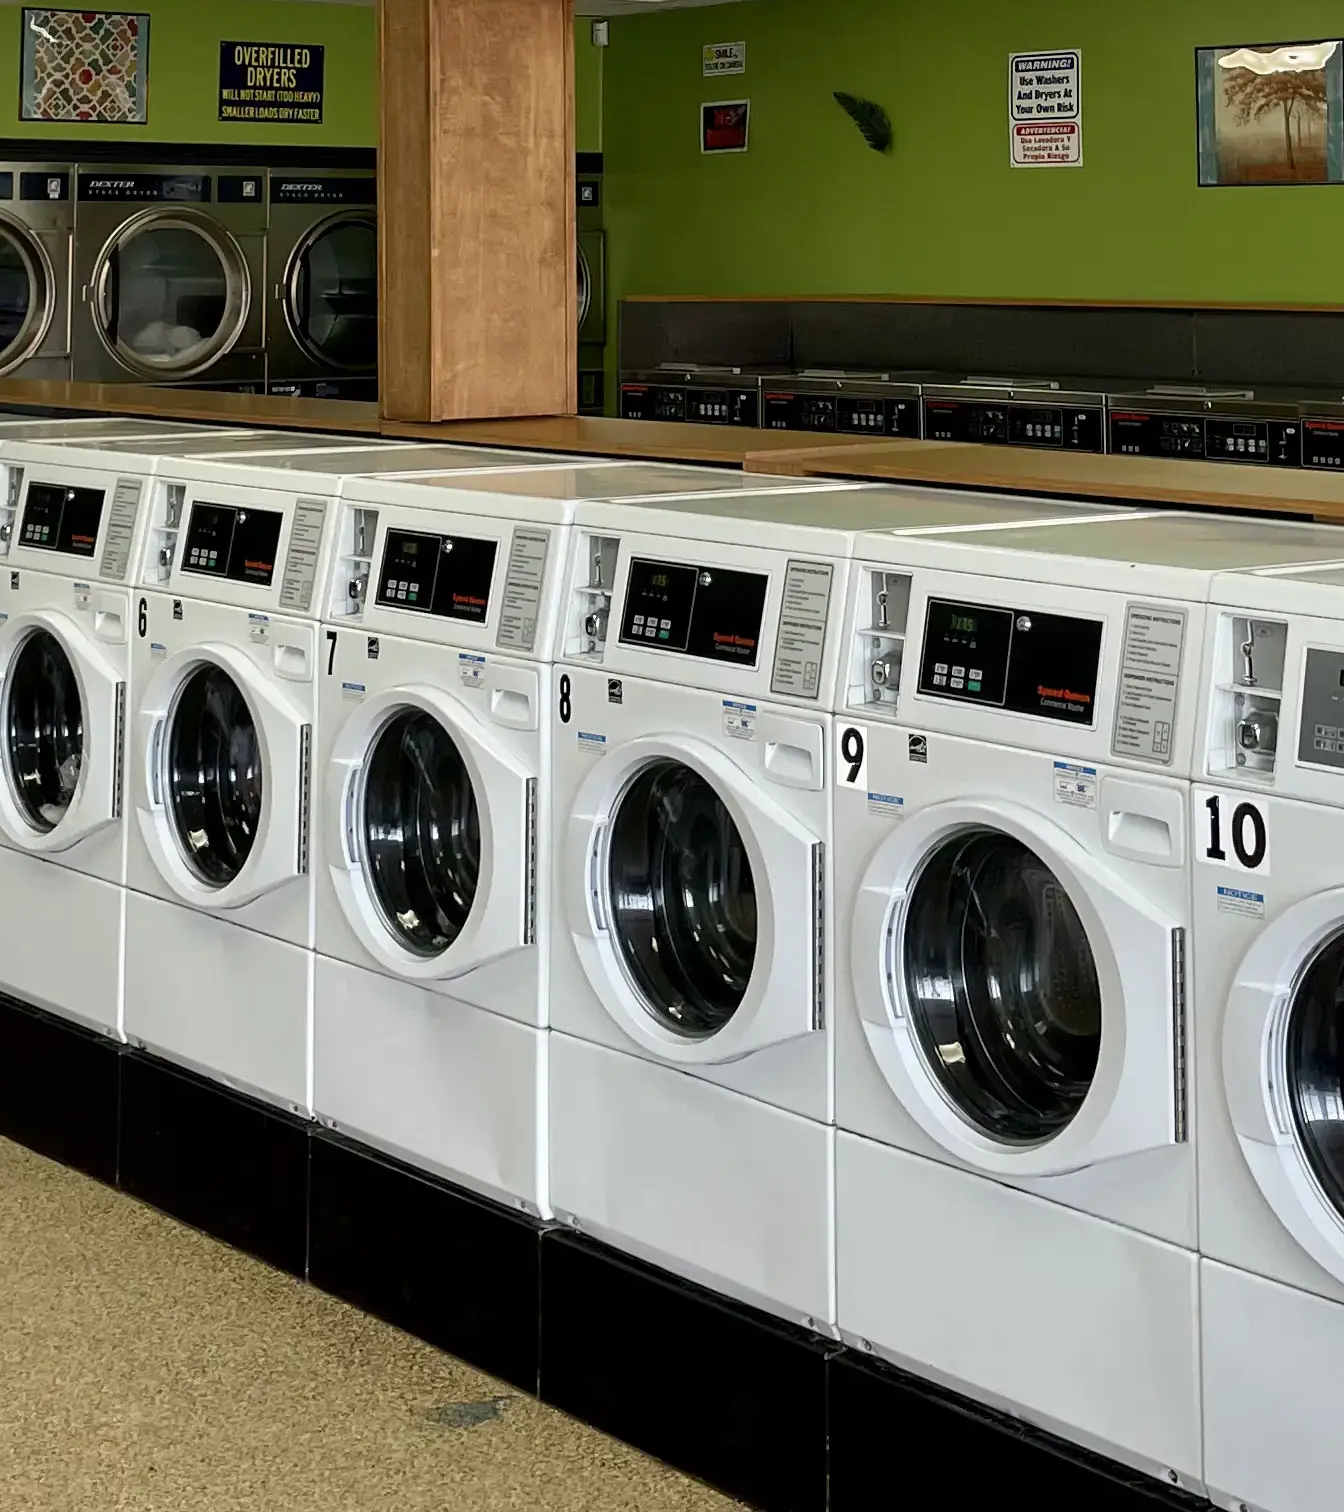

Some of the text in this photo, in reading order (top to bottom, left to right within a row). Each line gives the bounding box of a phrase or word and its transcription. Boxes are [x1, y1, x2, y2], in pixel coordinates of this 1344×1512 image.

[235, 46, 310, 68] OVERFILLED
[1018, 59, 1072, 70] WARNING!
[247, 67, 297, 88] DRYERS
[1020, 75, 1070, 86] Use Washers
[222, 89, 321, 103] WILL NOT START (TOO HEAVY)
[1017, 88, 1073, 101] And Dryers At
[221, 106, 255, 117] SMALLER
[255, 107, 278, 119] LOADS
[294, 108, 320, 120] FASTER
[1016, 102, 1074, 114] Your Own Risk
[139, 597, 147, 638] 6
[326, 631, 337, 676] 7
[559, 674, 571, 723] 8
[841, 727, 864, 783] 9
[1205, 795, 1266, 869] 10
